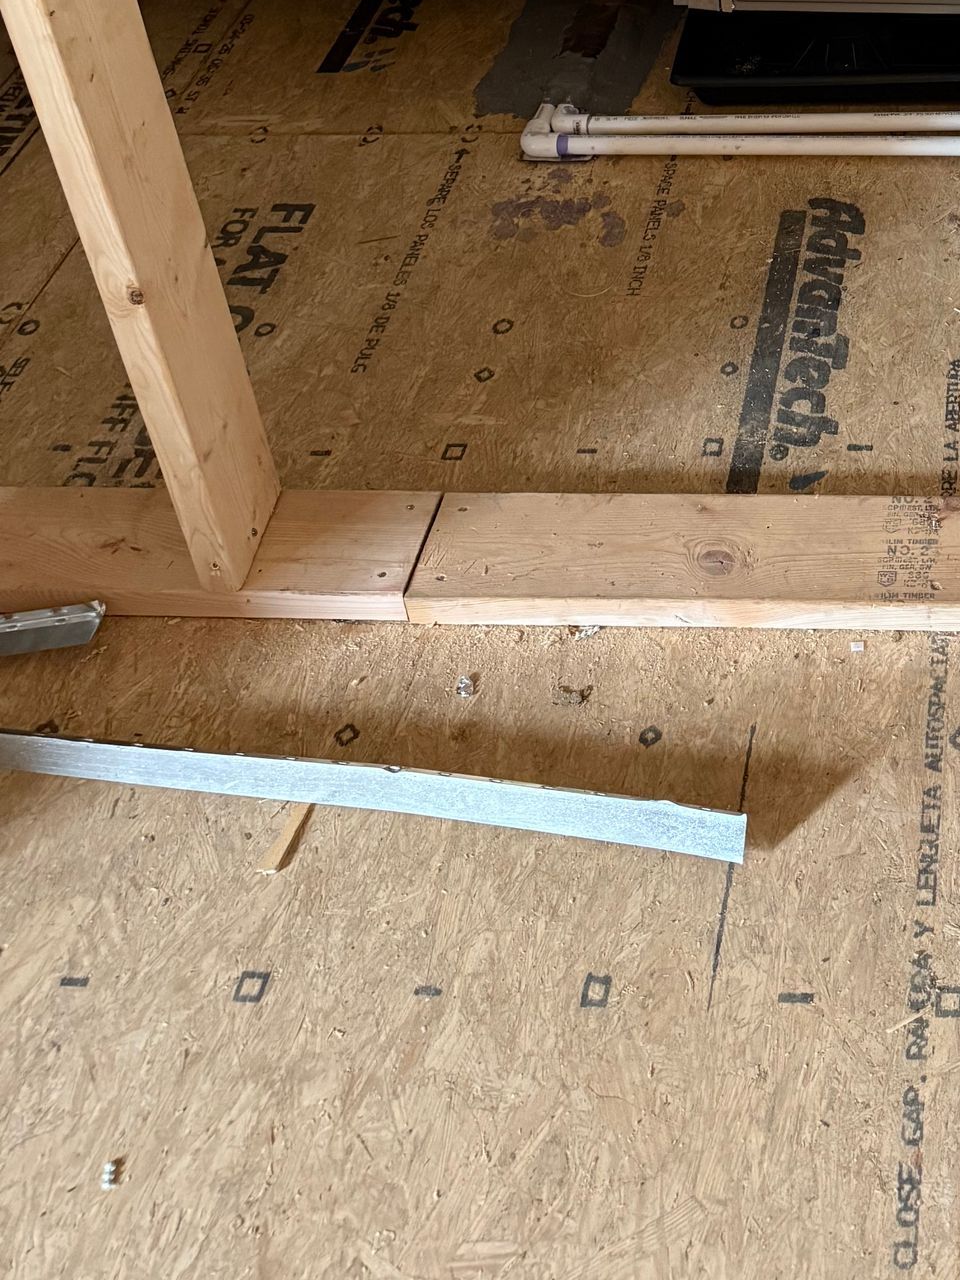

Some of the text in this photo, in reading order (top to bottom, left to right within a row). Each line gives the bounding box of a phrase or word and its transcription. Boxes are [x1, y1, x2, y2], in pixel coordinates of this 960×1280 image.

[211, 206, 259, 249] FOR
[642, 199, 667, 241] PANELS
[226, 203, 317, 295] FLAT
[626, 264, 648, 297] INCH
[369, 316, 391, 335] DE
[916, 782, 942, 907] LENGUETA
[912, 918, 935, 939] Y
[893, 1161, 922, 1271] CLOSE
